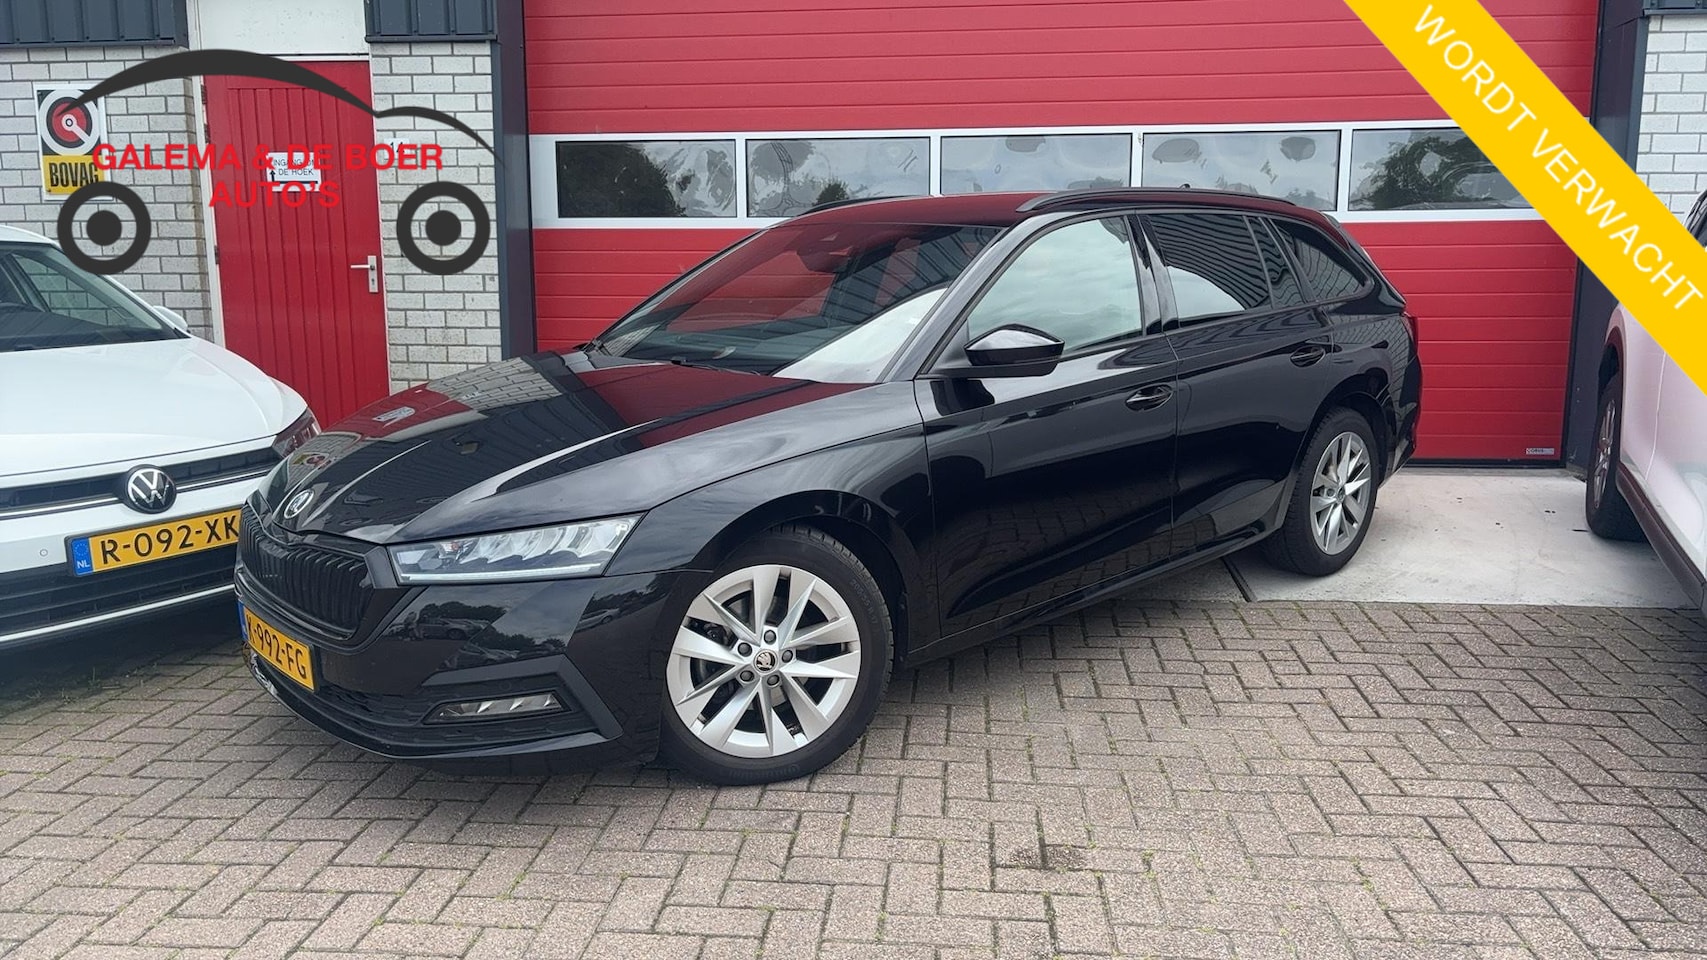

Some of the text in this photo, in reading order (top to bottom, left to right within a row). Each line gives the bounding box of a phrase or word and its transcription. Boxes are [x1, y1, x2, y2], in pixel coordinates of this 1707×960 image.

[49, 162, 99, 187] BOVAG
[278, 168, 314, 176] DE HOEK
[100, 515, 240, 564] R-092-XK
[76, 560, 90, 569] NL
[246, 614, 307, 679] K-992-FG
